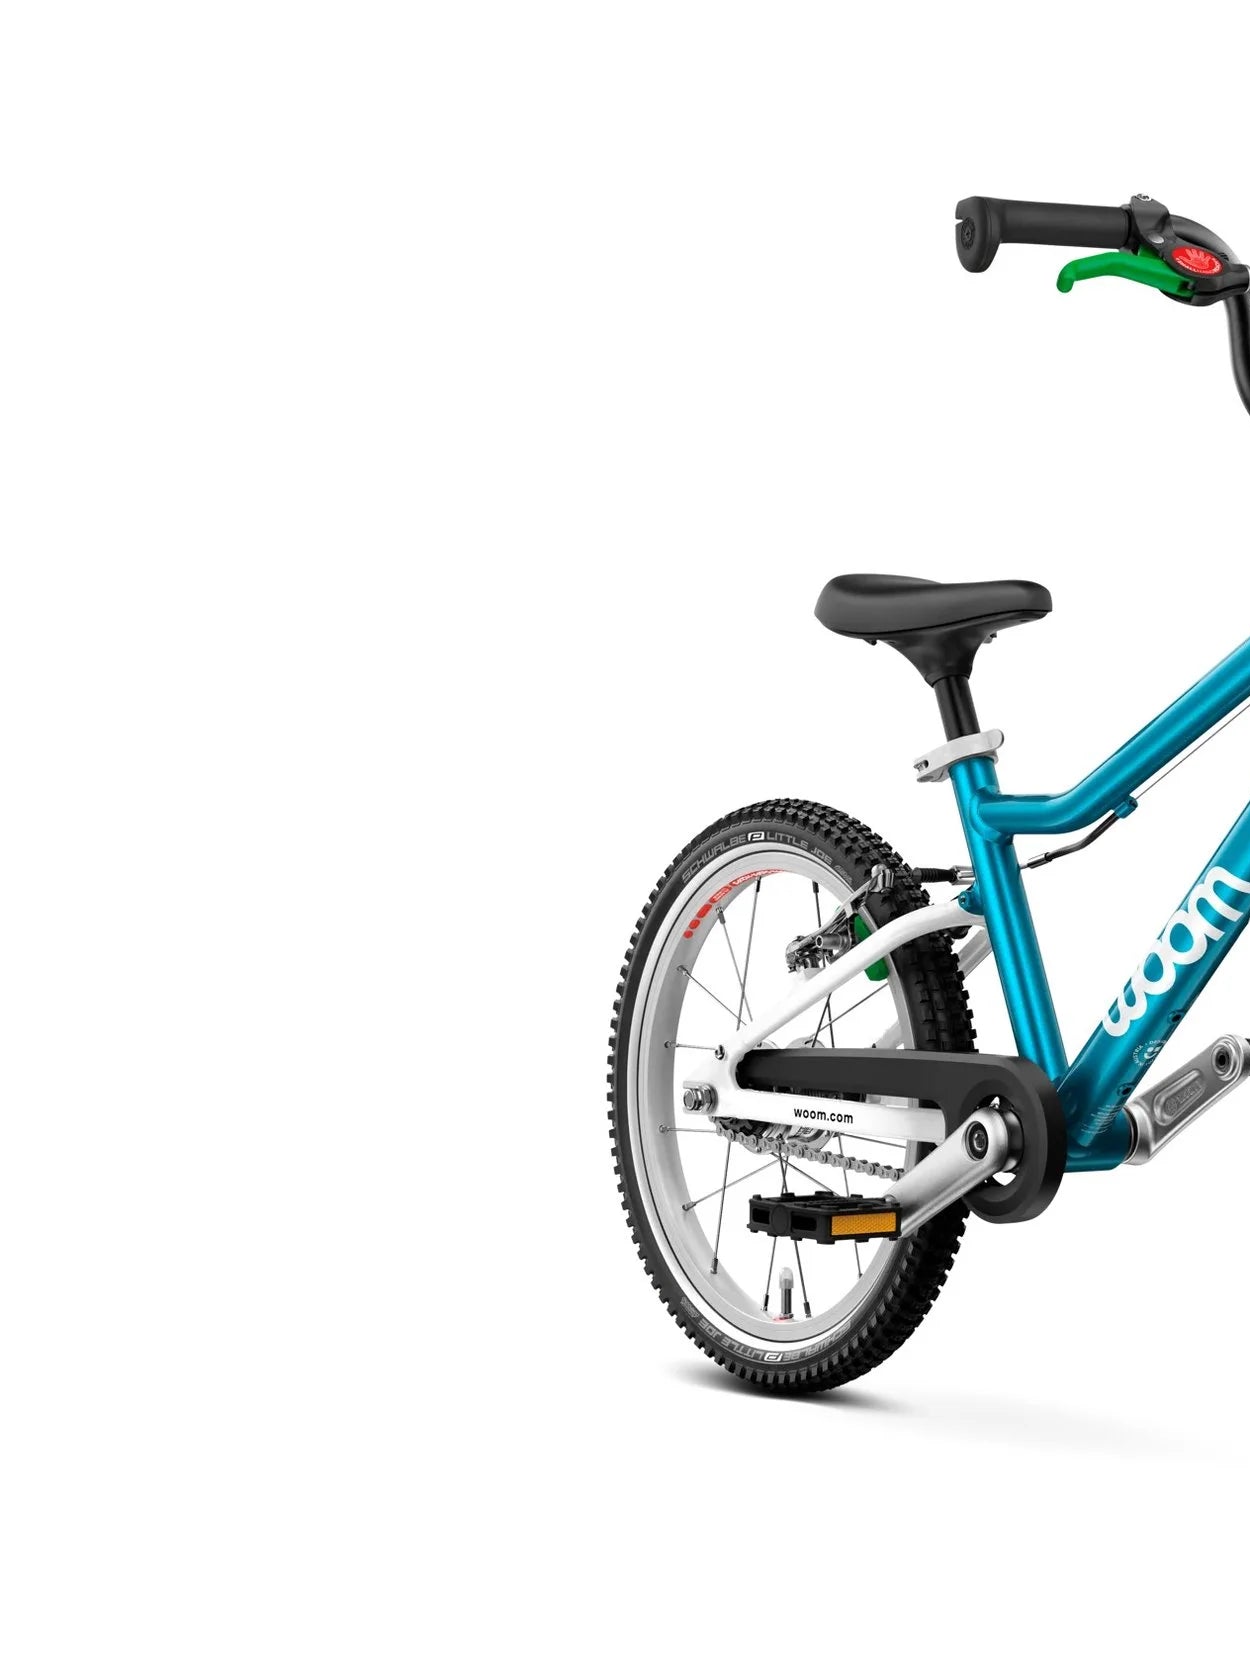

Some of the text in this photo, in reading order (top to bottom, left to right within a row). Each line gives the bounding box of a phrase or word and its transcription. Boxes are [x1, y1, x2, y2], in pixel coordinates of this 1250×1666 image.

[682, 834, 746, 884] SCHWALBE
[767, 831, 809, 850] LITTLE
[811, 847, 833, 865] JOE
[793, 1108, 854, 1124] woom.com
